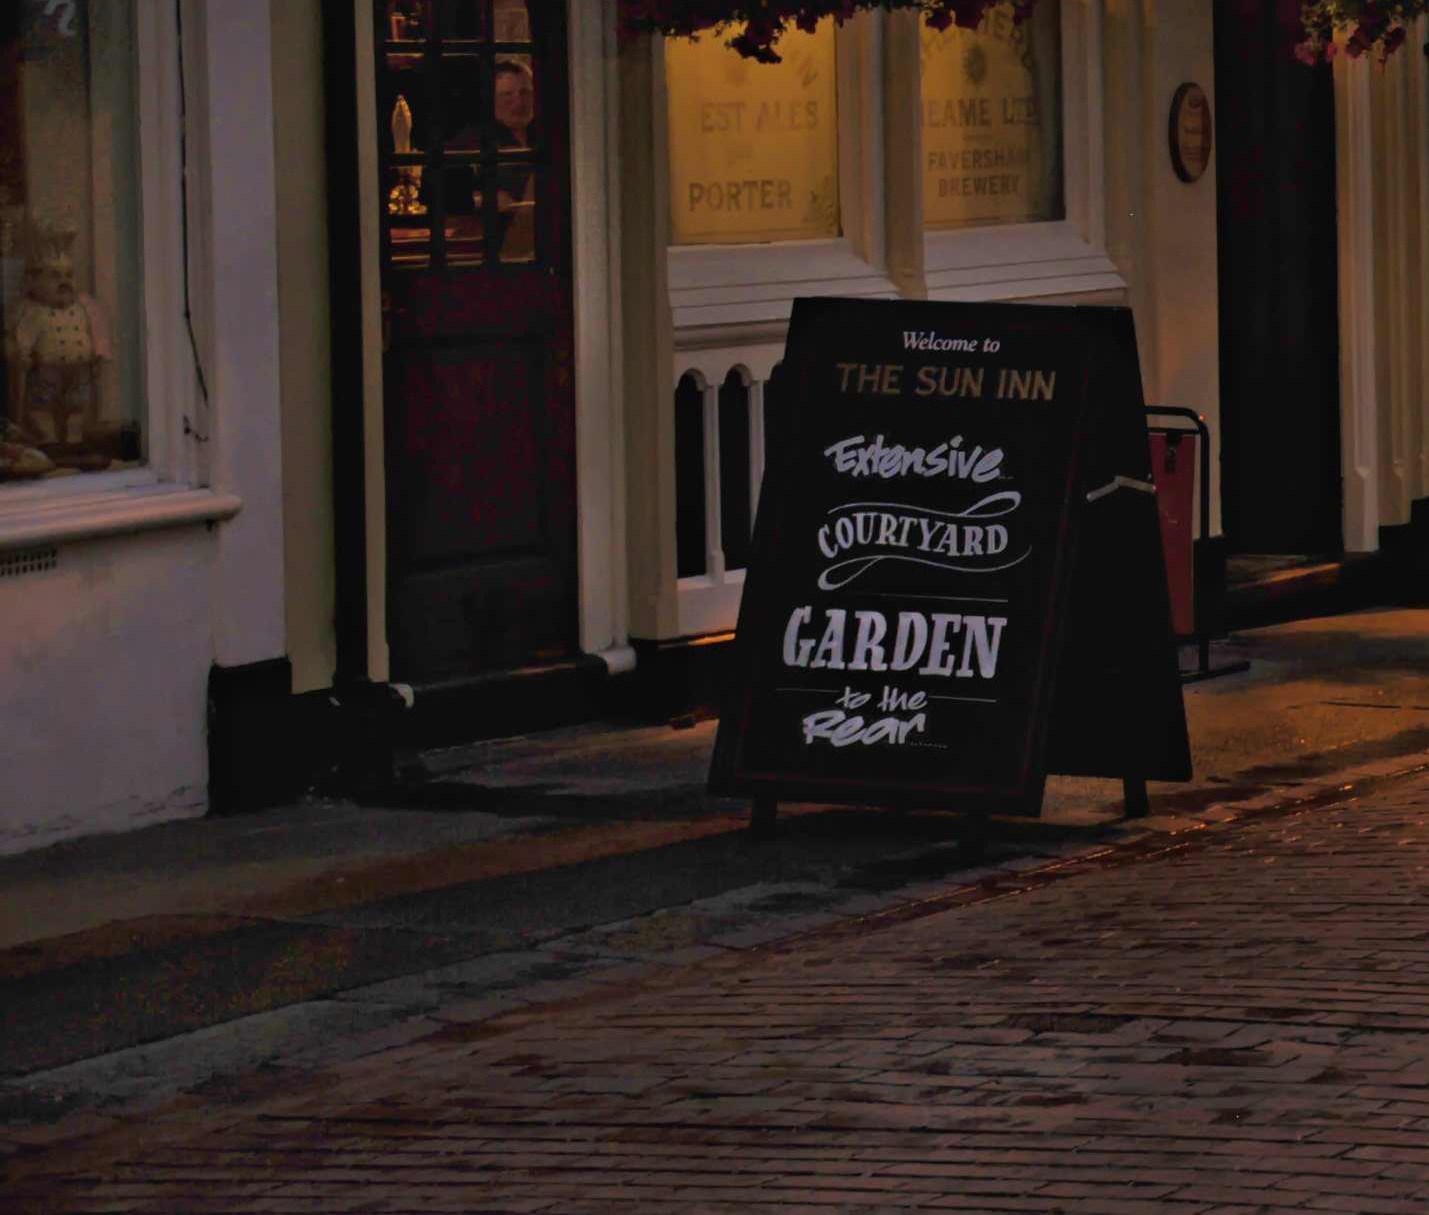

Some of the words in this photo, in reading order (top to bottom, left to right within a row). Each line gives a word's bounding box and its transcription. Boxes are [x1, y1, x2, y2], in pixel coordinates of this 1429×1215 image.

[920, 97, 992, 128] EAME
[927, 148, 1031, 172] FAVERSHAM
[688, 179, 793, 213] PORTER
[938, 173, 1021, 197] BREWERY
[903, 331, 977, 353] Welcome
[983, 336, 1000, 354] to
[836, 362, 904, 396] THE
[915, 365, 984, 398] SUN
[996, 369, 1056, 401] INN
[823, 434, 1004, 483] Extensive
[817, 512, 1009, 559] COURTYARD
[782, 605, 1008, 679] GARDEN
[836, 686, 870, 711] to
[877, 686, 928, 712] the
[802, 709, 926, 747] Rear
